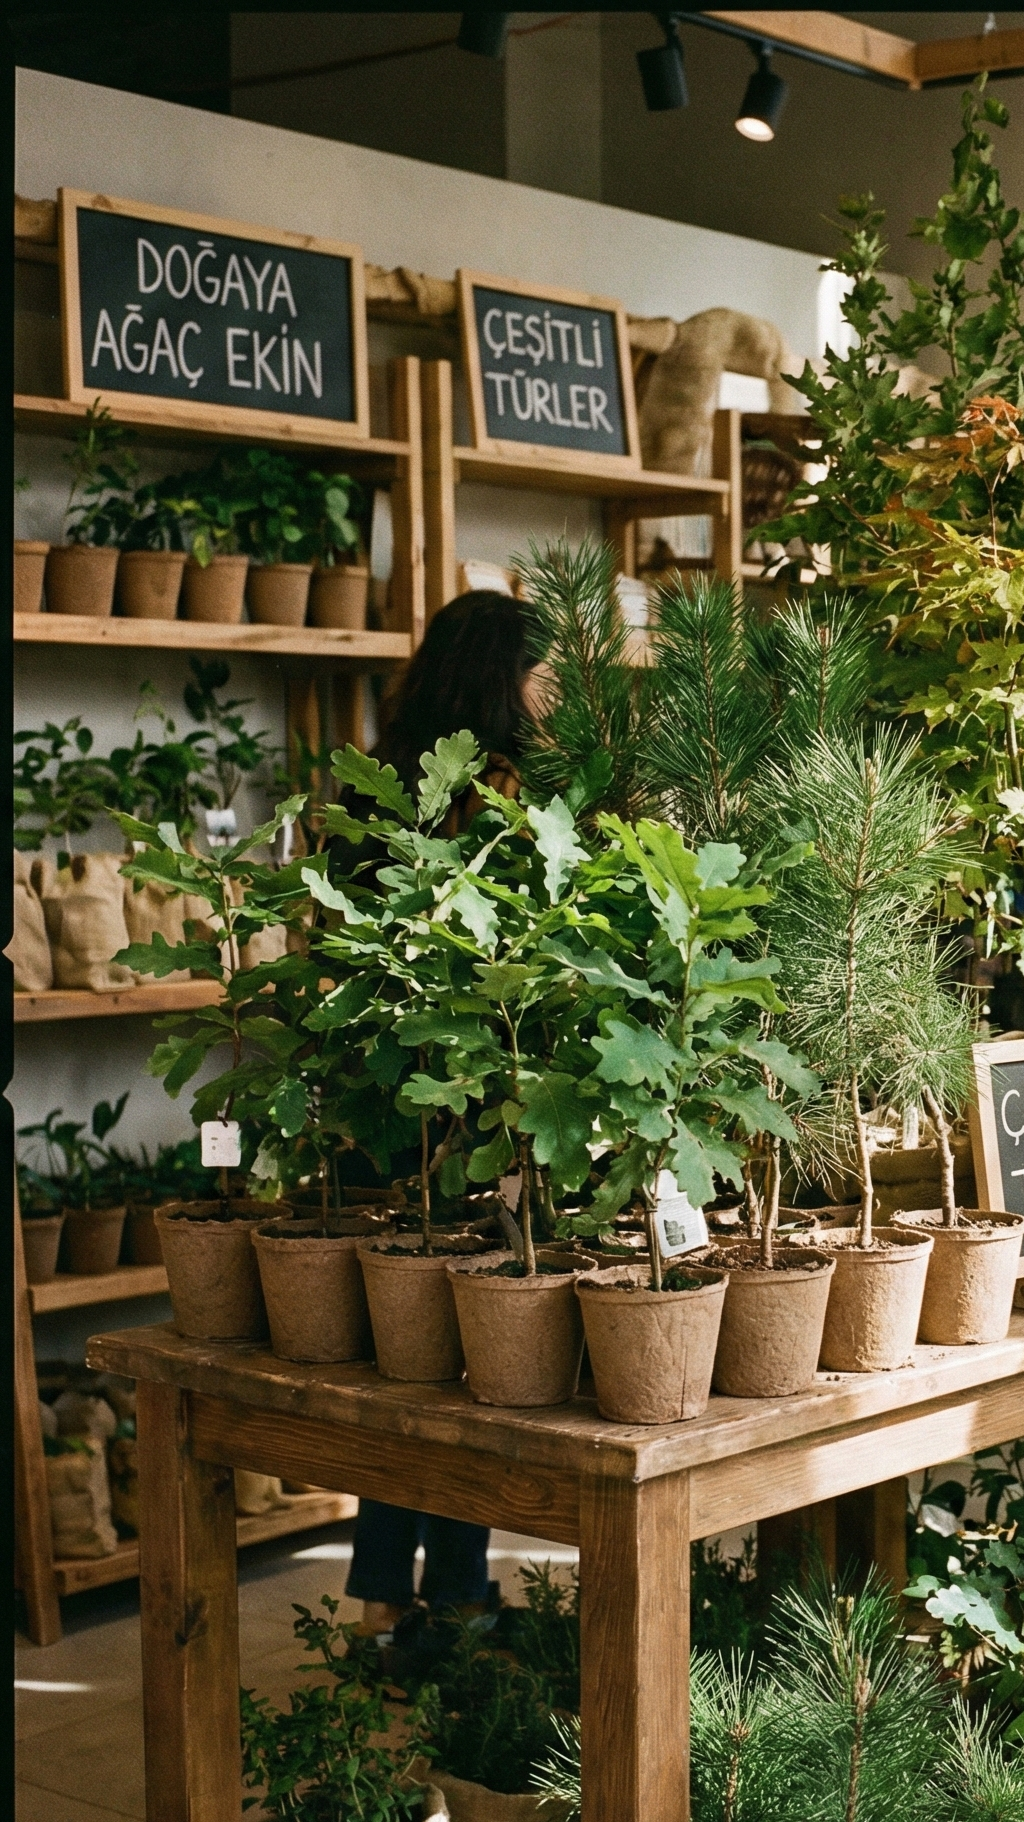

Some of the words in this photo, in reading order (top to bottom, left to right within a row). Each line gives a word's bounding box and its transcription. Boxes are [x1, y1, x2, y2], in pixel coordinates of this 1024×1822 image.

[226, 323, 323, 399] EKİN
[483, 308, 604, 369] ÇEŞİTLİ
[484, 368, 614, 434] TÜRLER
